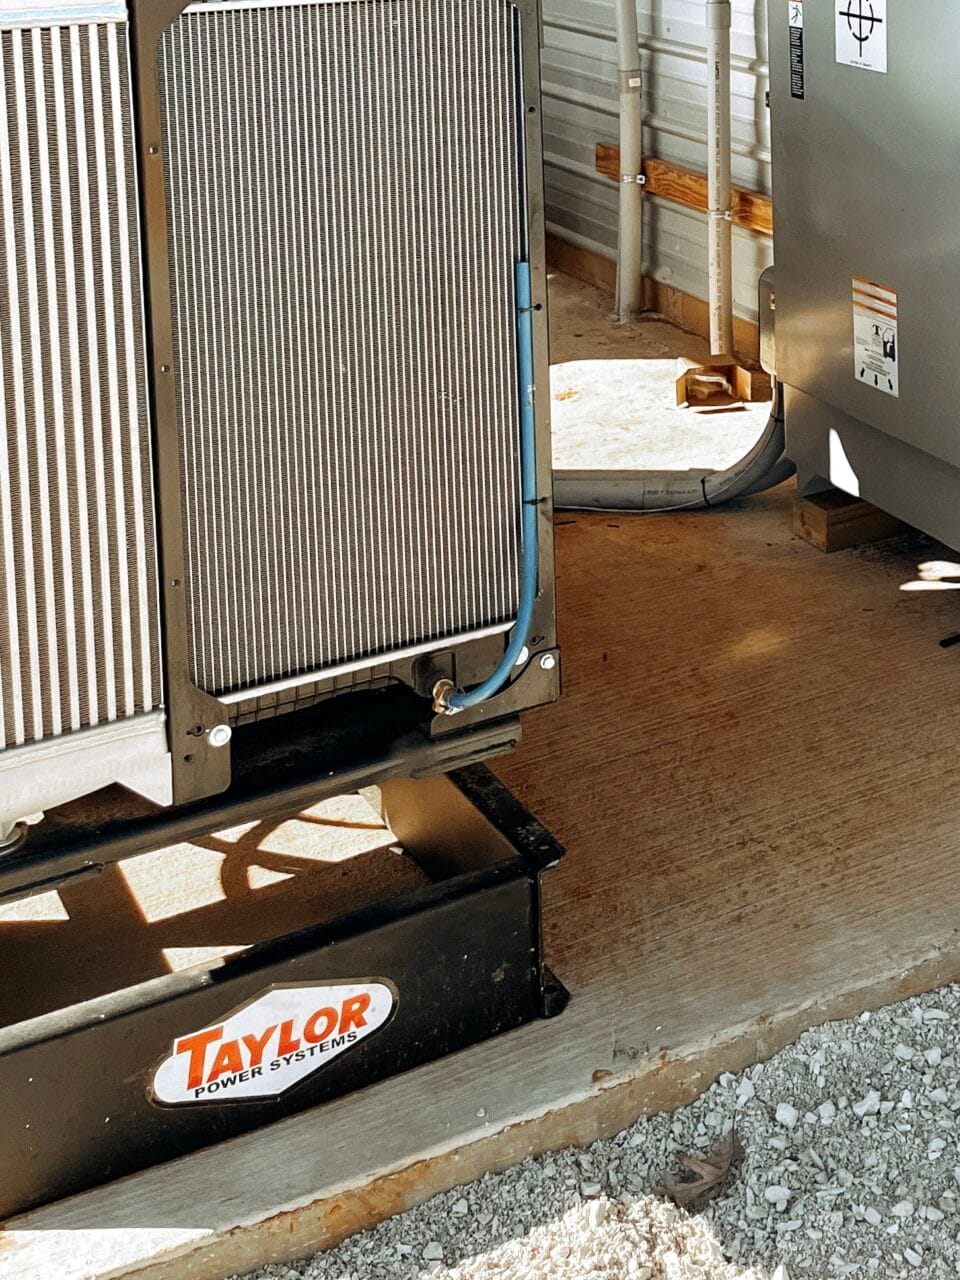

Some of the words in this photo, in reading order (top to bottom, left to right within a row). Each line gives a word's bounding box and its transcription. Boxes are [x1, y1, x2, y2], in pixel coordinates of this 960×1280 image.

[176, 992, 371, 1090] TAYLOR
[195, 1068, 263, 1099] POWER
[270, 1031, 358, 1071] SYSTEMS
